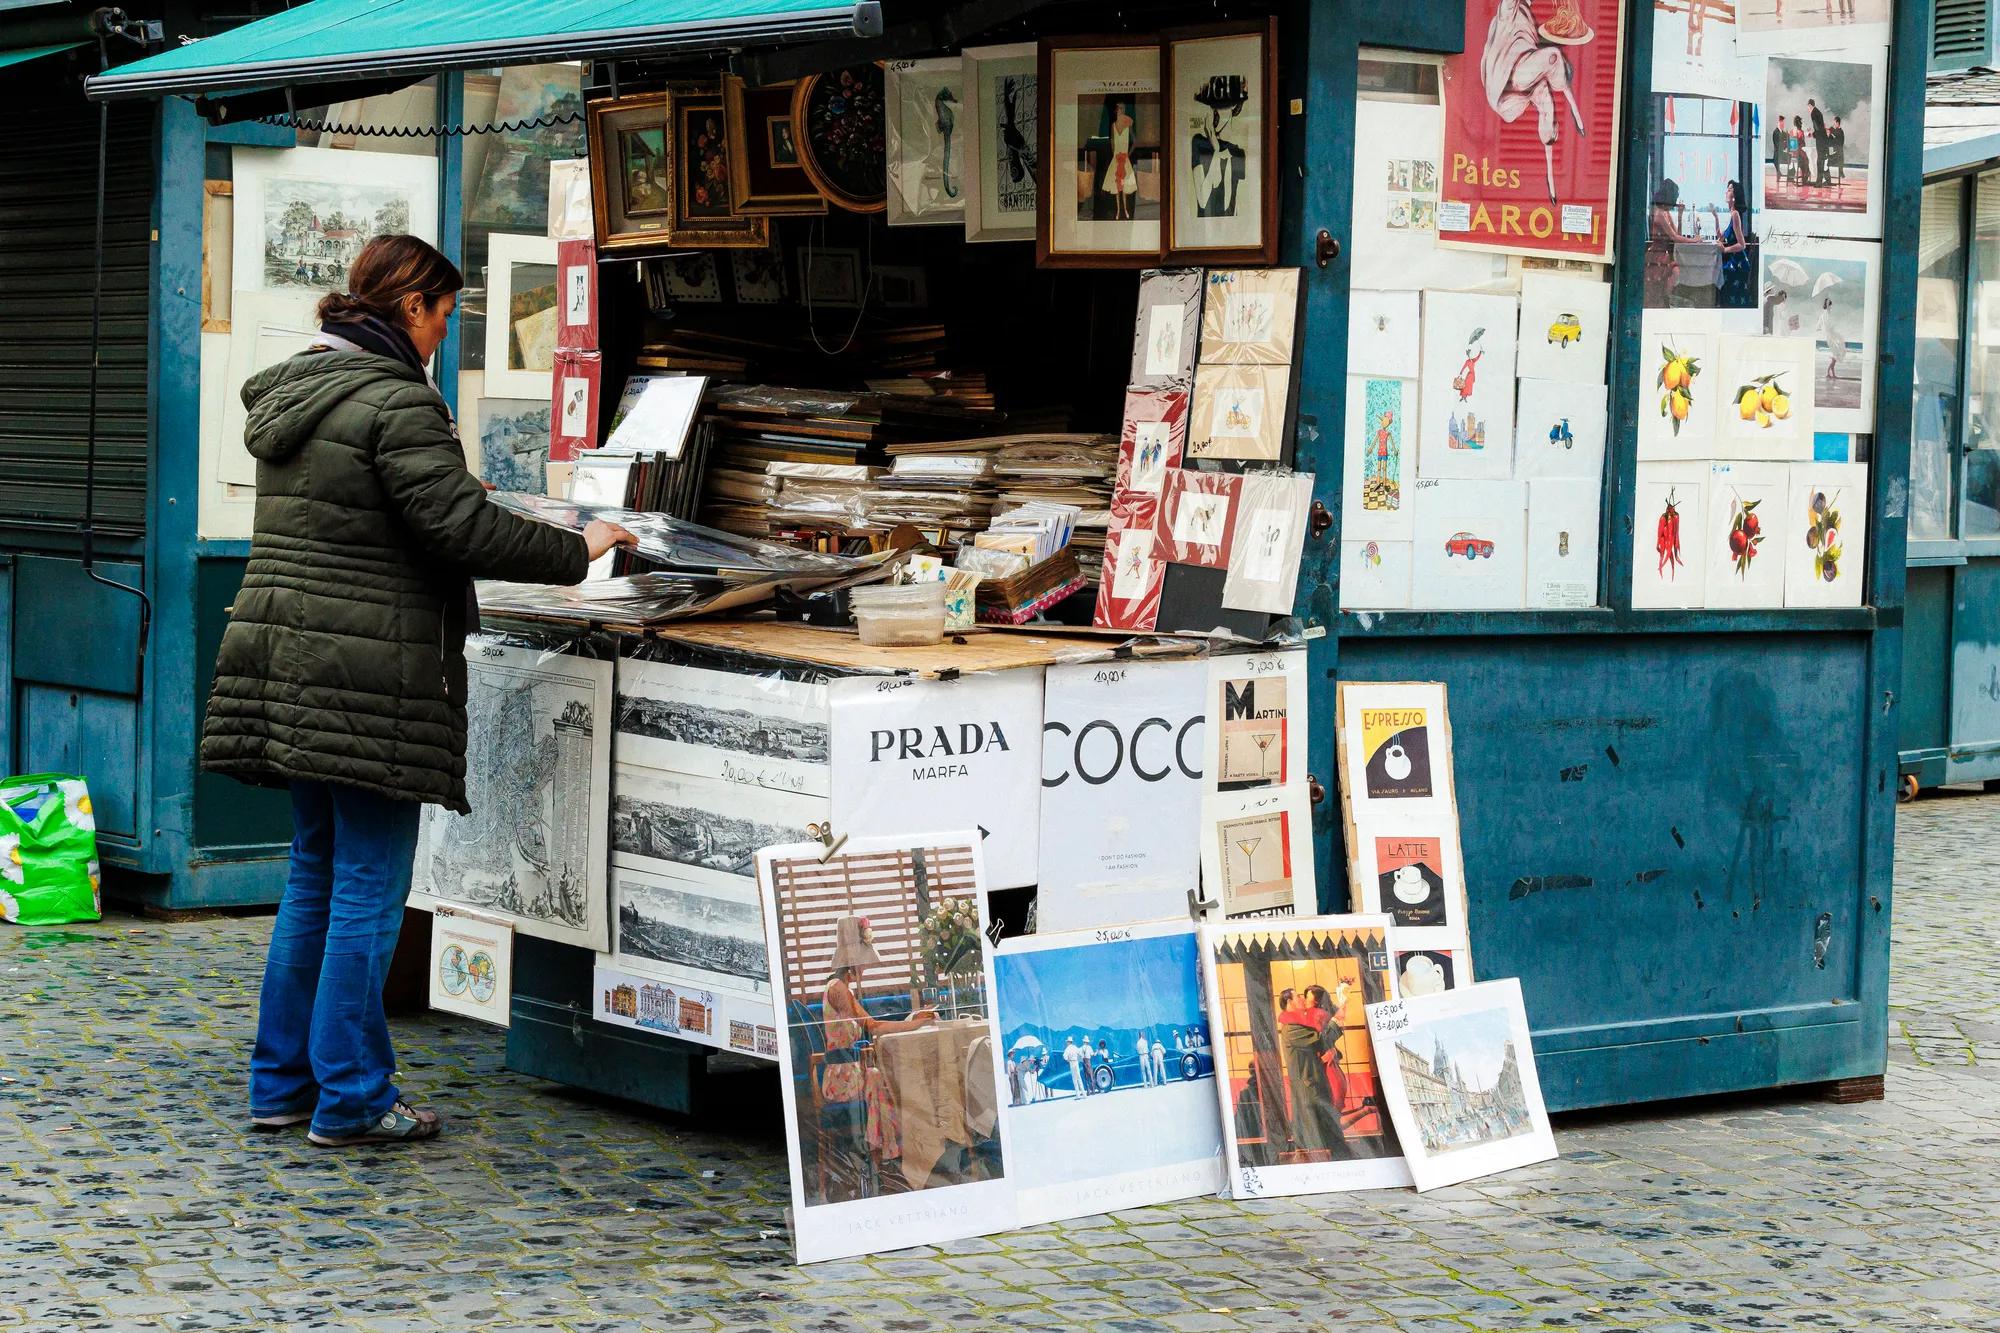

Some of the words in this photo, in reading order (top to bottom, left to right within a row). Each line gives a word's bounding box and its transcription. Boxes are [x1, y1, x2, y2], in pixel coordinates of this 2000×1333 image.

[1452, 153, 1521, 189] Pâtes
[1447, 201, 1600, 245] AROI
[1363, 712, 1424, 730] ESPRESSO
[869, 721, 1010, 762] PRADA
[912, 764, 969, 780] MARFA
[1388, 843, 1428, 857] LATTE
[1373, 955, 1387, 967] LE
[1076, 1188, 1112, 1204] JACK
[849, 1217, 881, 1234] JACK
